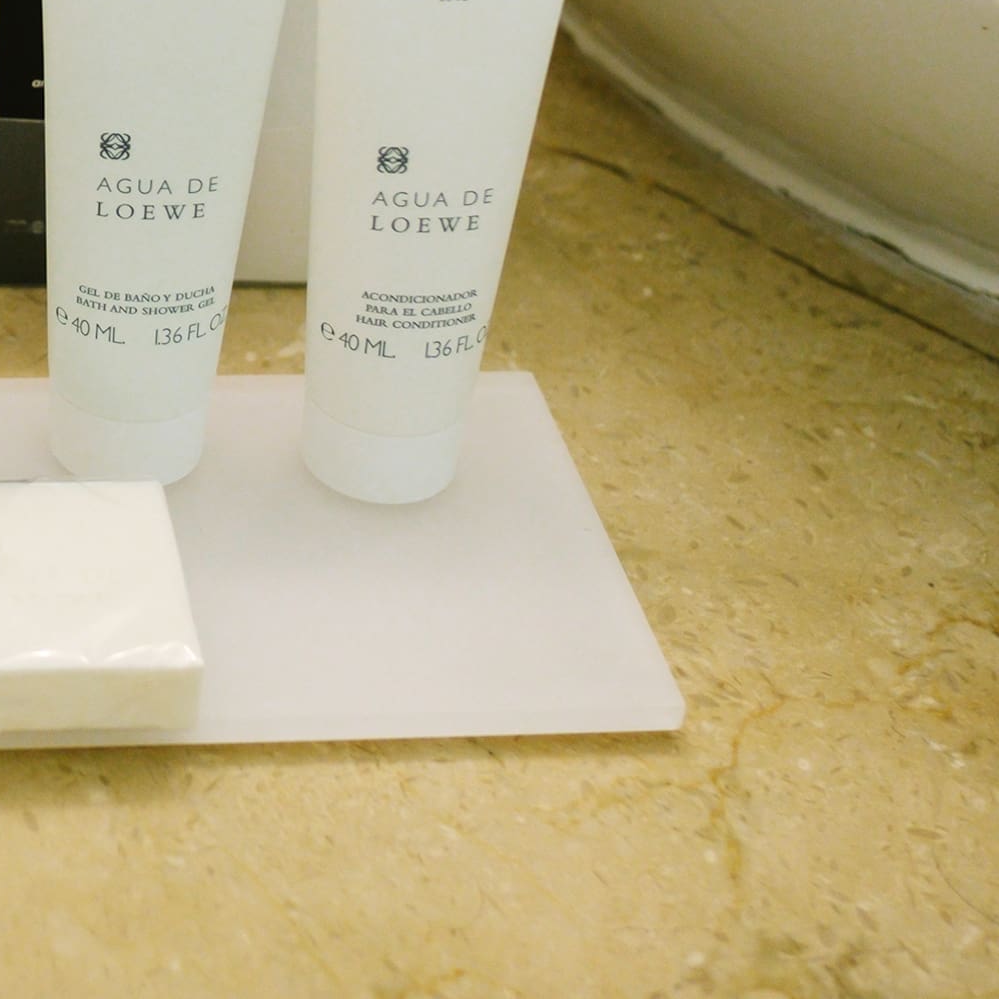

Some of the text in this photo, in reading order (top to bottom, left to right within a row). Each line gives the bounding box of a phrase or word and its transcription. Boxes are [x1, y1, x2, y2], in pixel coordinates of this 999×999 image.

[96, 176, 219, 195] AGUA DE
[372, 188, 494, 208] AGUA DE
[96, 201, 205, 220] LOEWE
[371, 215, 480, 234] LOEWE
[78, 284, 215, 303] GEL DE BAÑO Y DUCHA
[361, 289, 477, 304] ACONDICIONADOR
[76, 296, 216, 316] BATH AND SHOWER GEL
[365, 302, 472, 317] PARA EL CABELLO
[356, 313, 476, 329] HAIR CONDITIONER
[72, 317, 90, 336] 40
[155, 323, 183, 345] 1.36
[339, 333, 359, 351] 40
